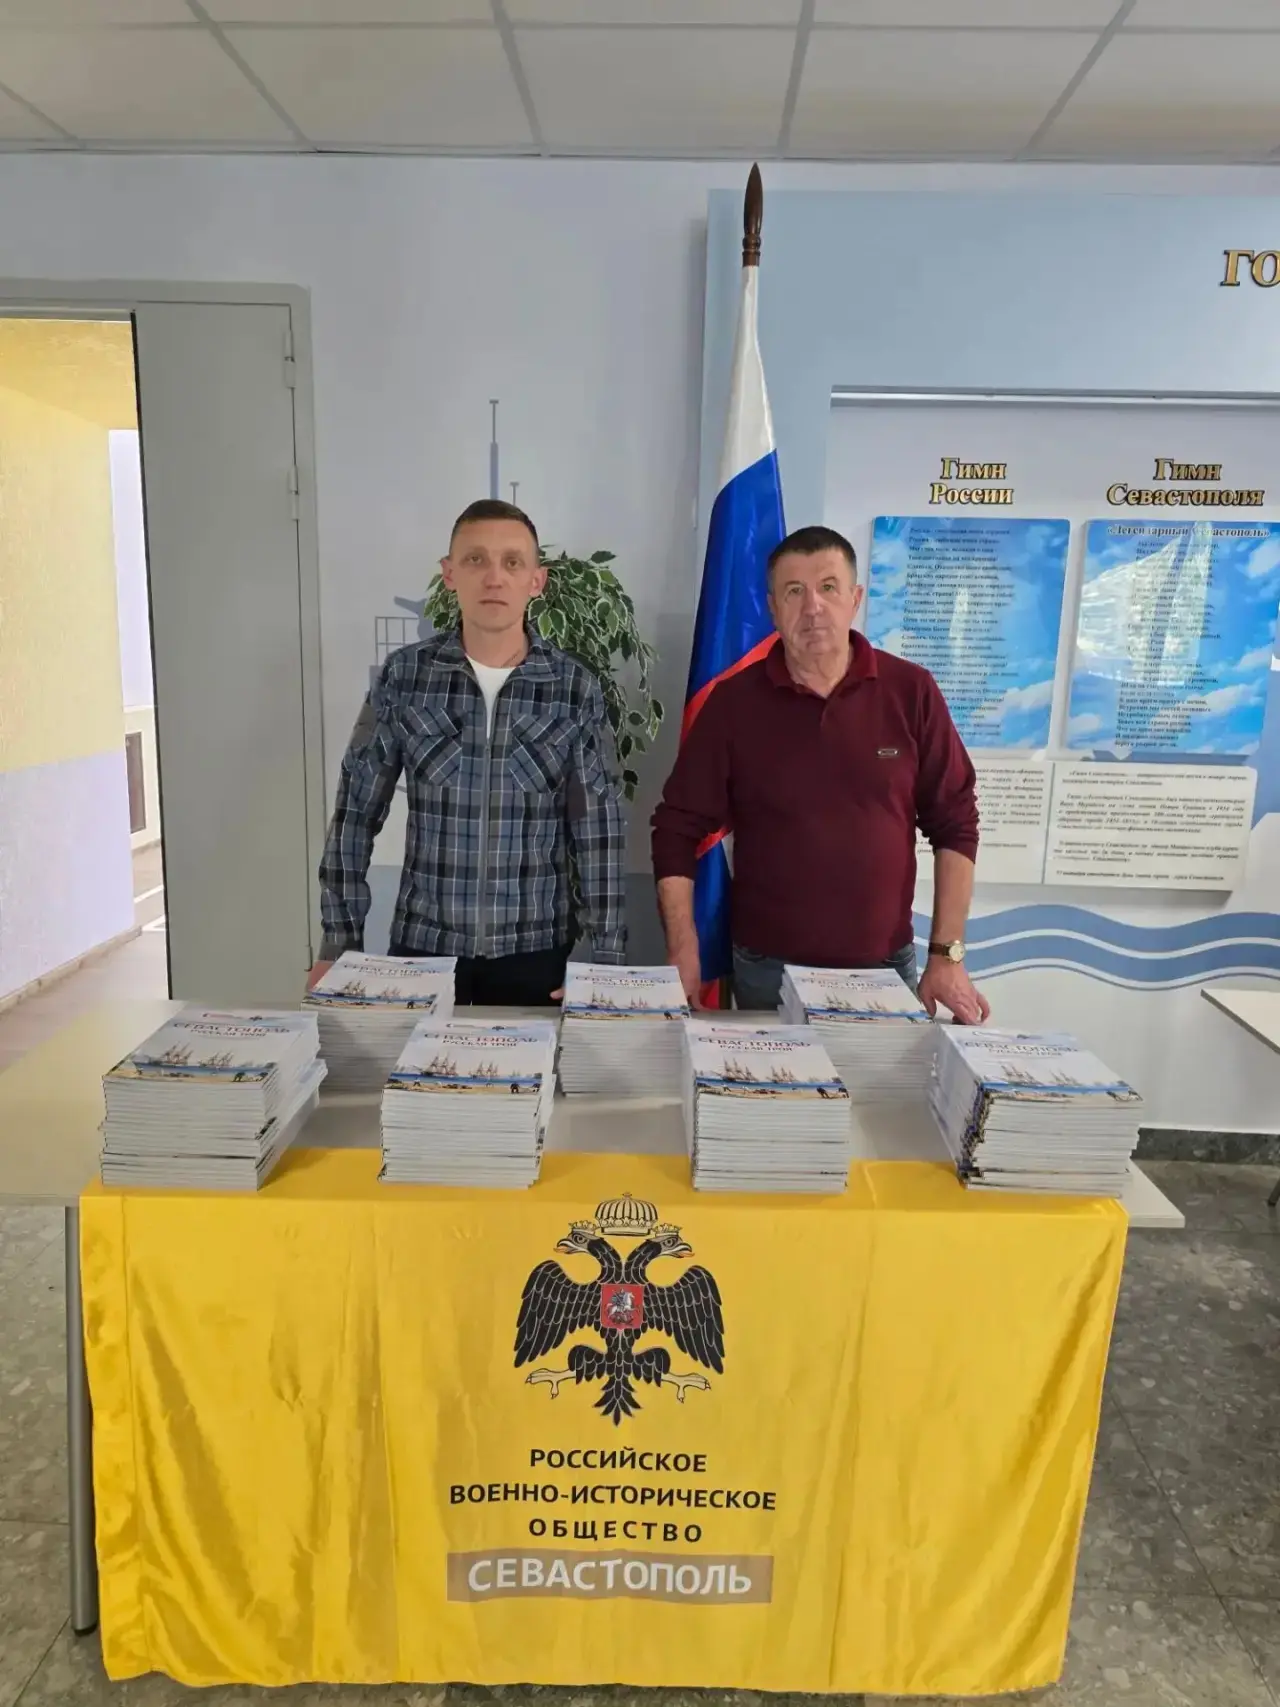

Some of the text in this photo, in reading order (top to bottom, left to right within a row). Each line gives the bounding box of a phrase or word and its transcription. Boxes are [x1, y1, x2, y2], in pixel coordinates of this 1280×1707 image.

[941, 457, 1007, 480] Гимн
[1153, 458, 1222, 481] Гимн
[929, 482, 1014, 505] России
[1106, 483, 1265, 507] Севастополя
[698, 1036, 811, 1048] СЕВАСТОПОЛЬ
[530, 1446, 708, 1473] РОССИЙСКОЕ
[450, 1483, 777, 1511] ВОЕННО-ИСТОРИЧЕСКОЕ
[528, 1518, 702, 1543] ОБЩЕСТВО
[468, 1558, 752, 1595] СЕВАСТОПОЛЬ
